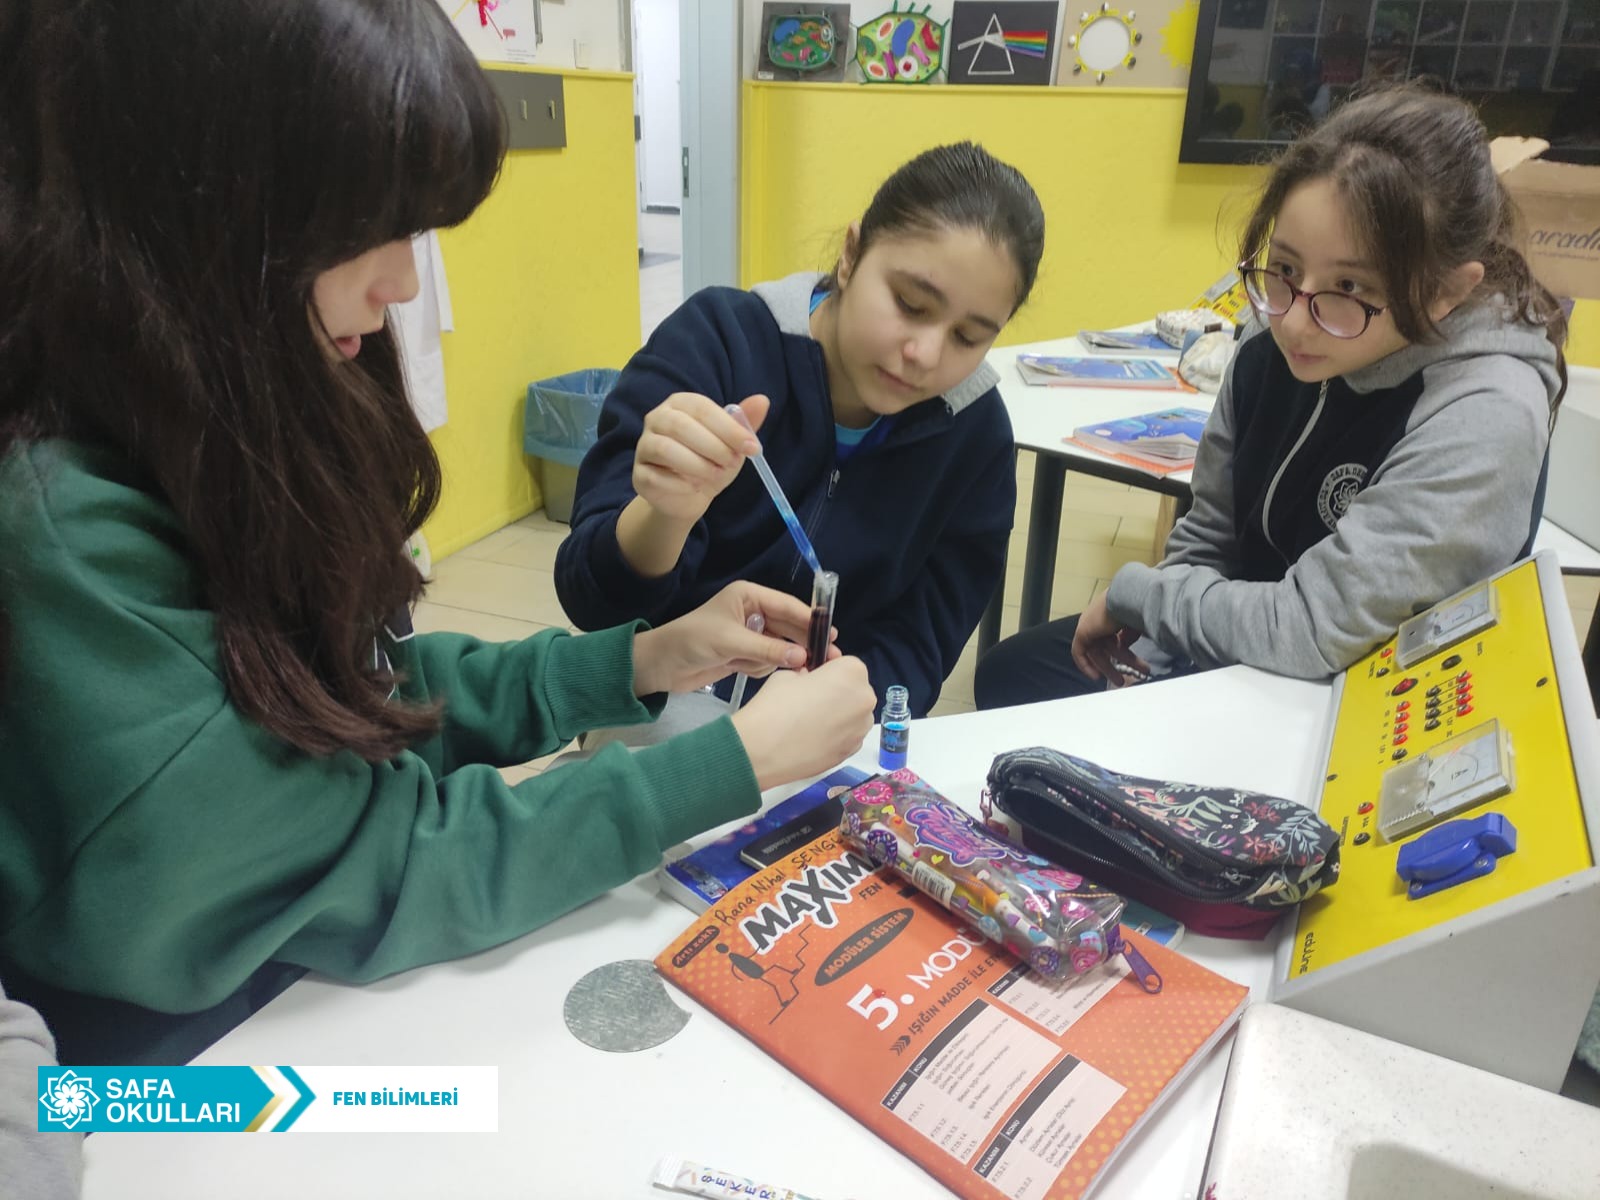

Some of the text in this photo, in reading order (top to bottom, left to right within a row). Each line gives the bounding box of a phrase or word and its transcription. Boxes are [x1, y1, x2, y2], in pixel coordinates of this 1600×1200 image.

[714, 896, 756, 926] Rana
[751, 868, 786, 894] Nihal
[858, 882, 883, 900] FEN
[824, 911, 908, 977] MODÜLER SİSTEM
[846, 983, 915, 1031] 5.
[908, 1004, 940, 1036] IŞIĞIN
[937, 977, 972, 1009] MADDE
[969, 963, 987, 981] İLE
[701, 1173, 772, 1200] ŞEKER
